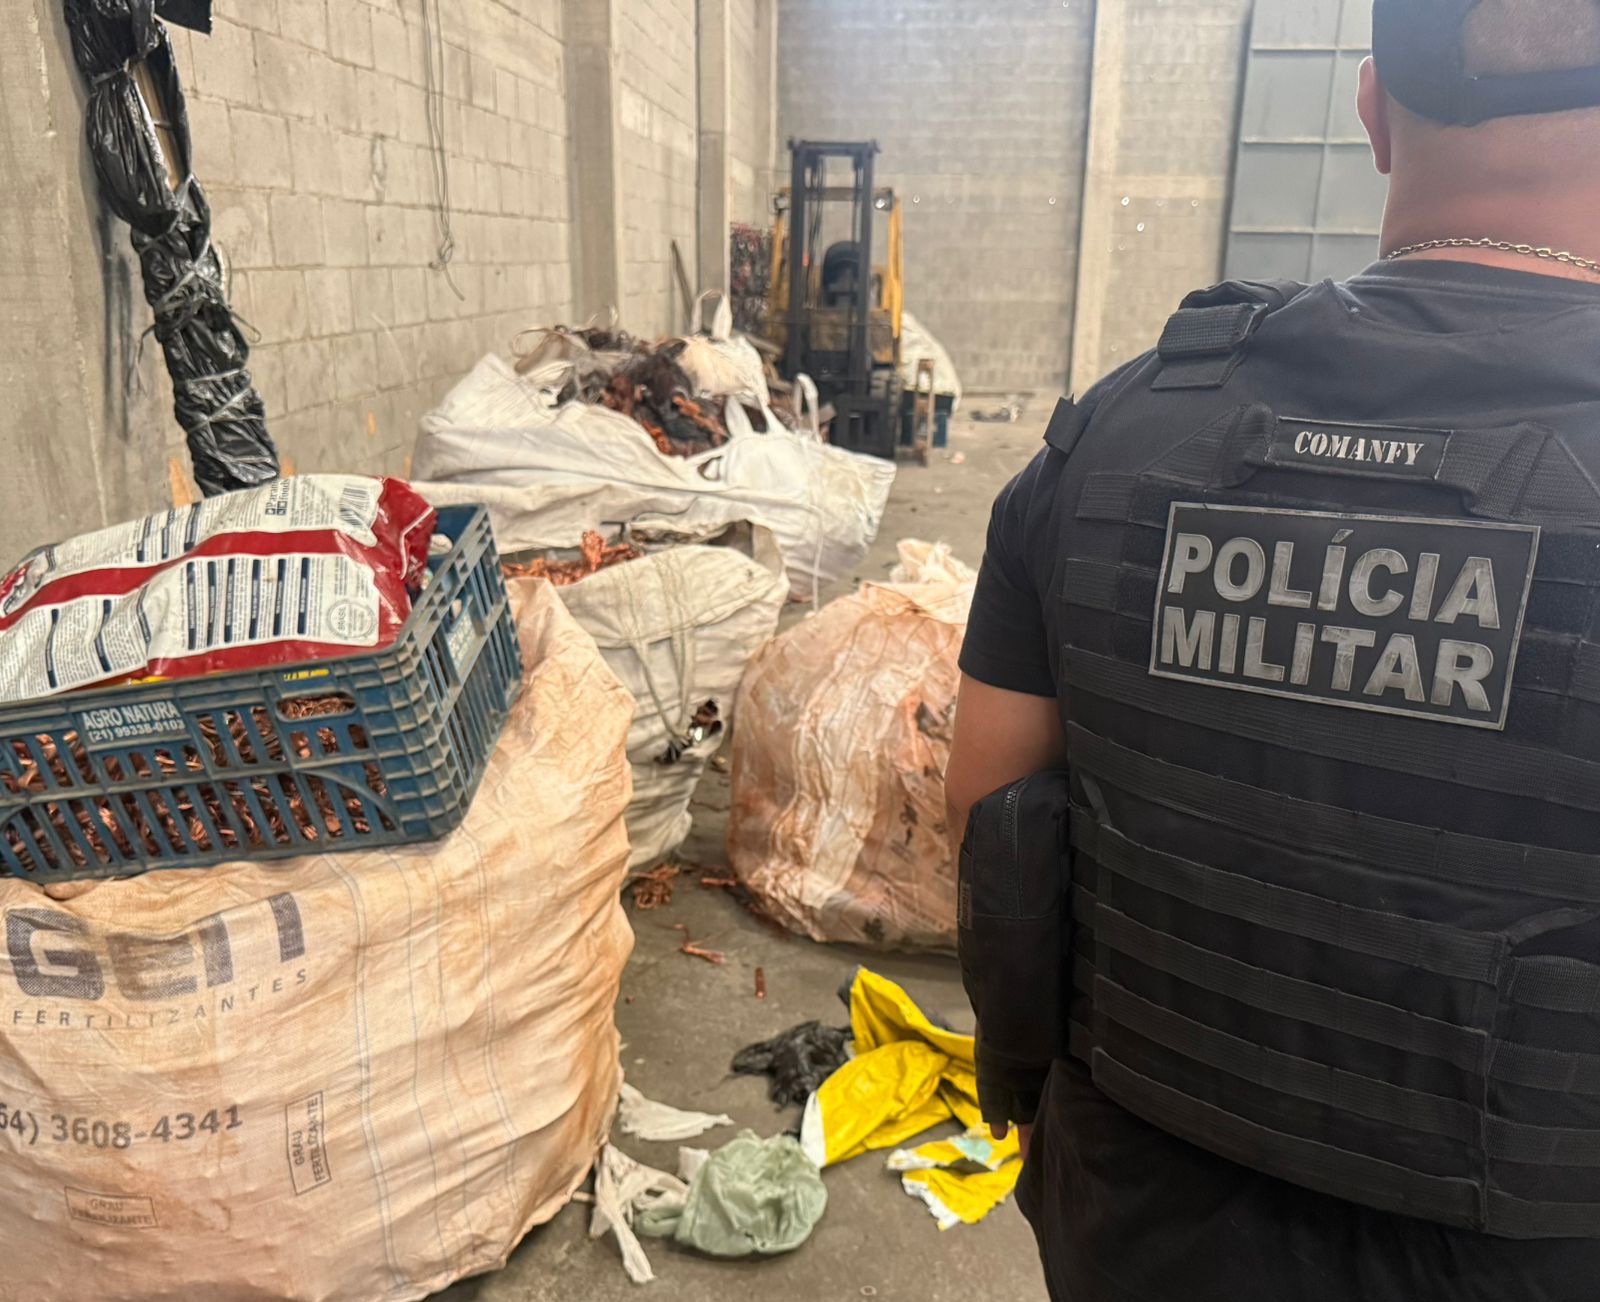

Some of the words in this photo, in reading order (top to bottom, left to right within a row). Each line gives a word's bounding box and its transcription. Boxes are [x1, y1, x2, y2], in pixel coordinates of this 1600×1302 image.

[1294, 430, 1425, 466] COMANFY
[1167, 529, 1501, 629] POLÍCIA
[1160, 606, 1495, 712] MILITAR
[81, 707, 124, 730] AGRO
[120, 701, 181, 724] NATURA
[88, 729, 114, 743] (21)
[13, 968, 308, 1029] FERTILIZANTES
[50, 1104, 243, 1150] 3608-4341
[292, 1130, 305, 1166] GRAU
